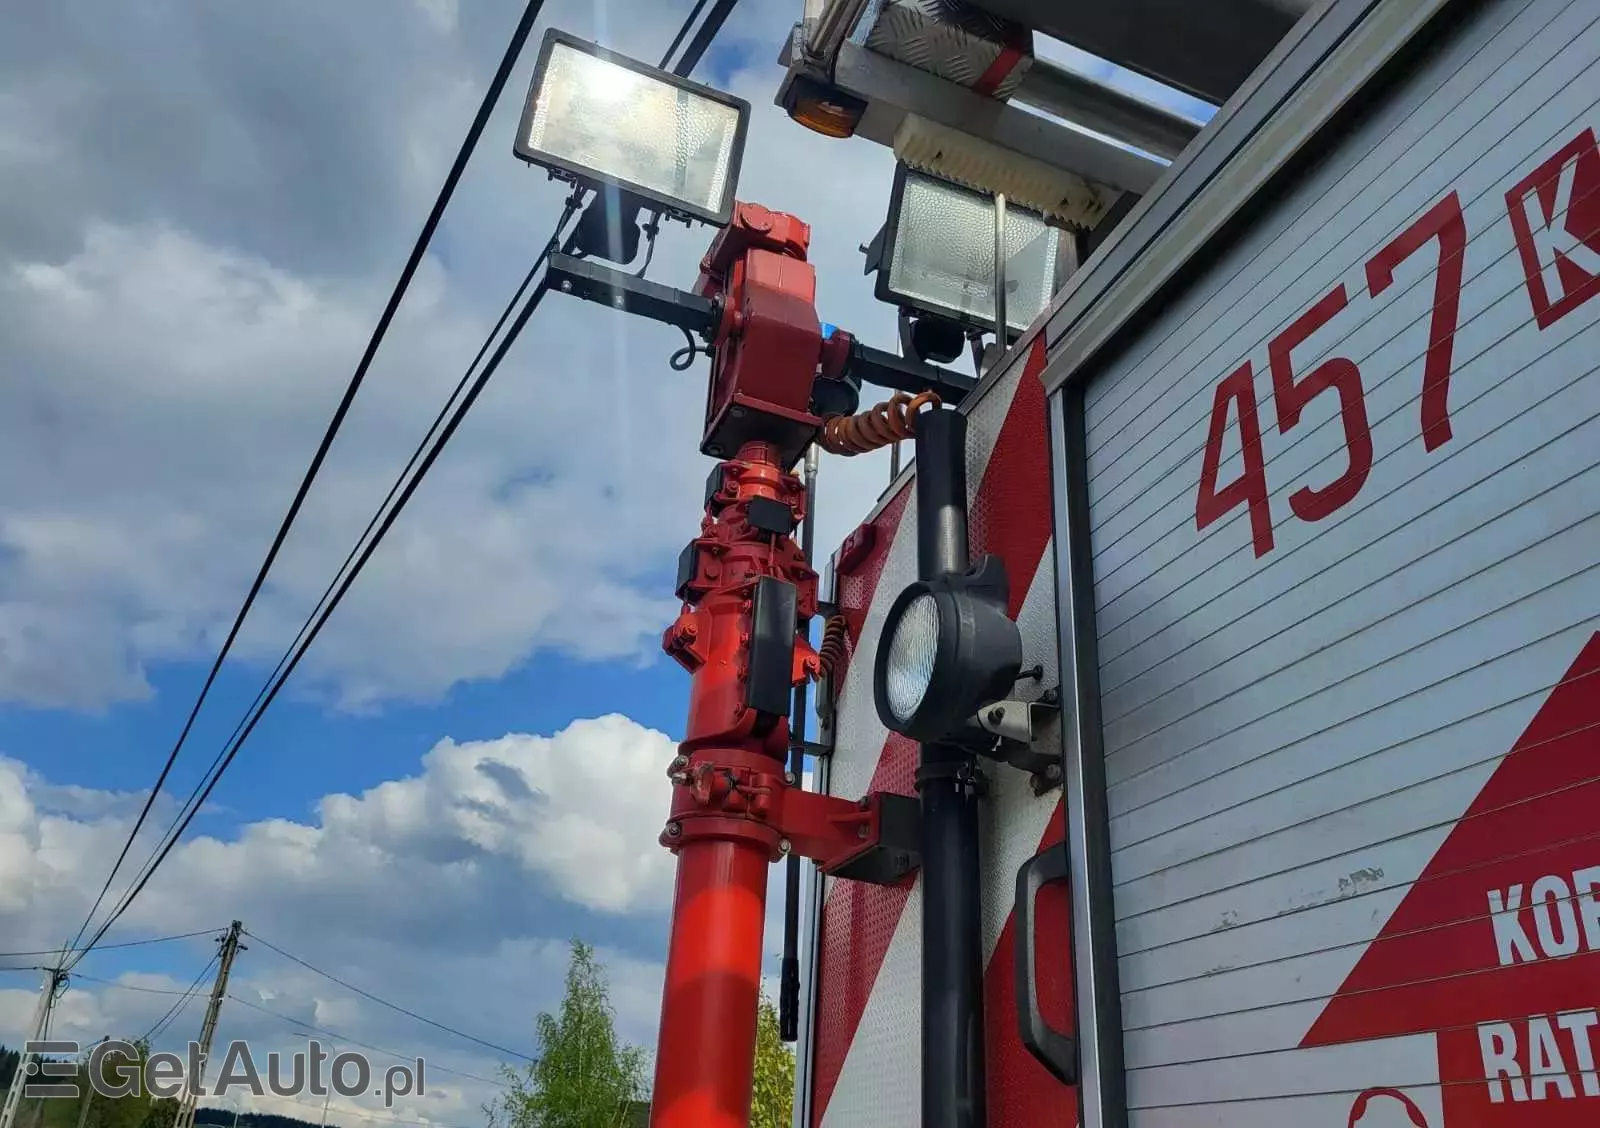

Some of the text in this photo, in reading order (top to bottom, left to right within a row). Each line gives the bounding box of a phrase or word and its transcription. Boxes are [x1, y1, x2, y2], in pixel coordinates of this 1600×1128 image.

[1196, 152, 1600, 559] 457 K
[1476, 1007, 1600, 1103] RAT
